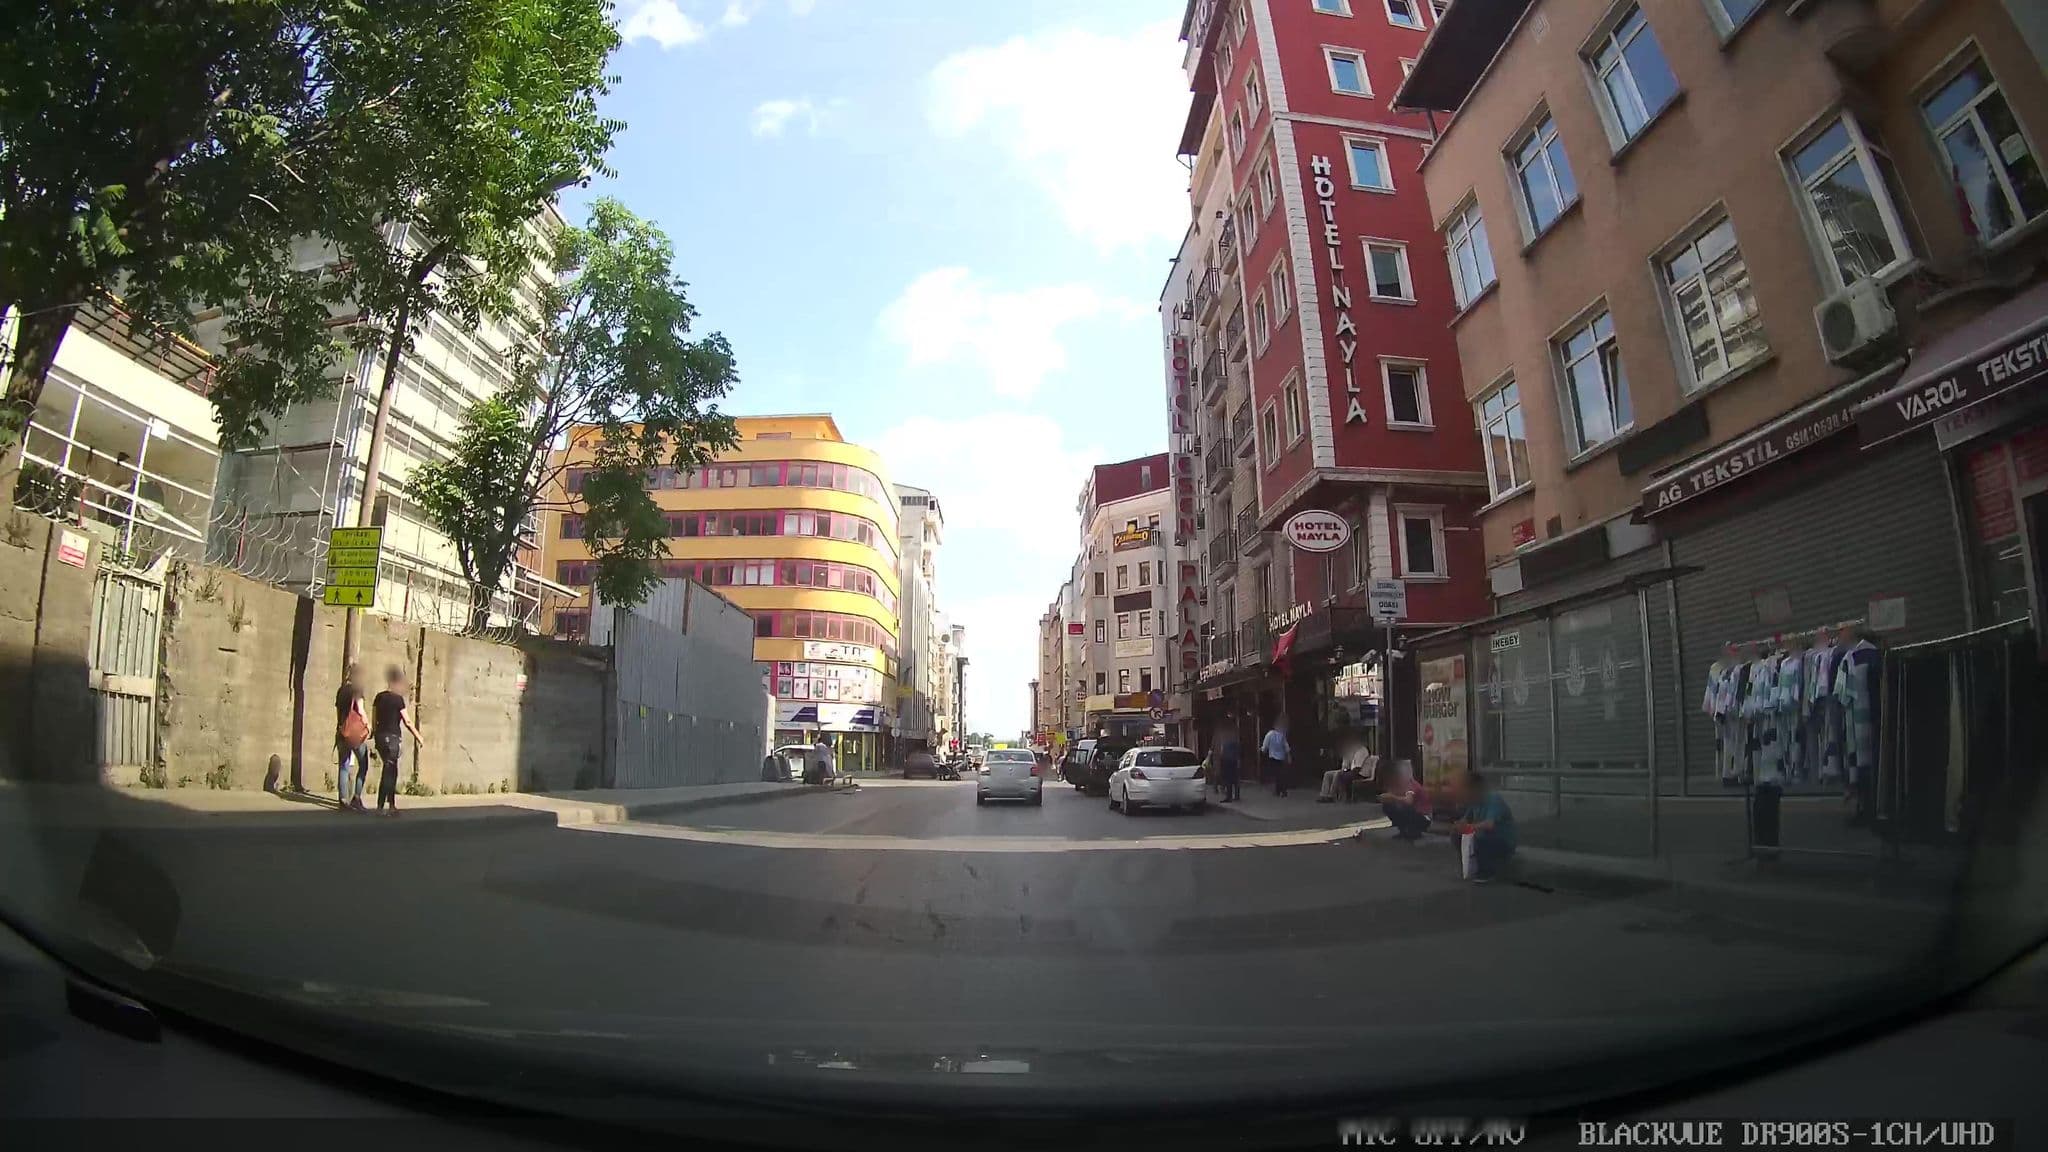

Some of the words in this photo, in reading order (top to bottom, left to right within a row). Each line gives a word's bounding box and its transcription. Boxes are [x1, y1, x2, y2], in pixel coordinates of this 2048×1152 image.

[1310, 155, 1345, 270] HOTEL
[1332, 284, 1368, 424] NAYLA
[1172, 338, 1190, 431] HOTEL
[1896, 377, 1967, 421] VAROL
[1657, 481, 1682, 508] AĞ
[1690, 440, 1780, 492] TEKSTİL
[1294, 521, 1342, 531] HOTEL
[1297, 532, 1342, 541] NAYLA
[1180, 564, 1199, 670] PALAS
[1268, 611, 1290, 633] HOTEL
